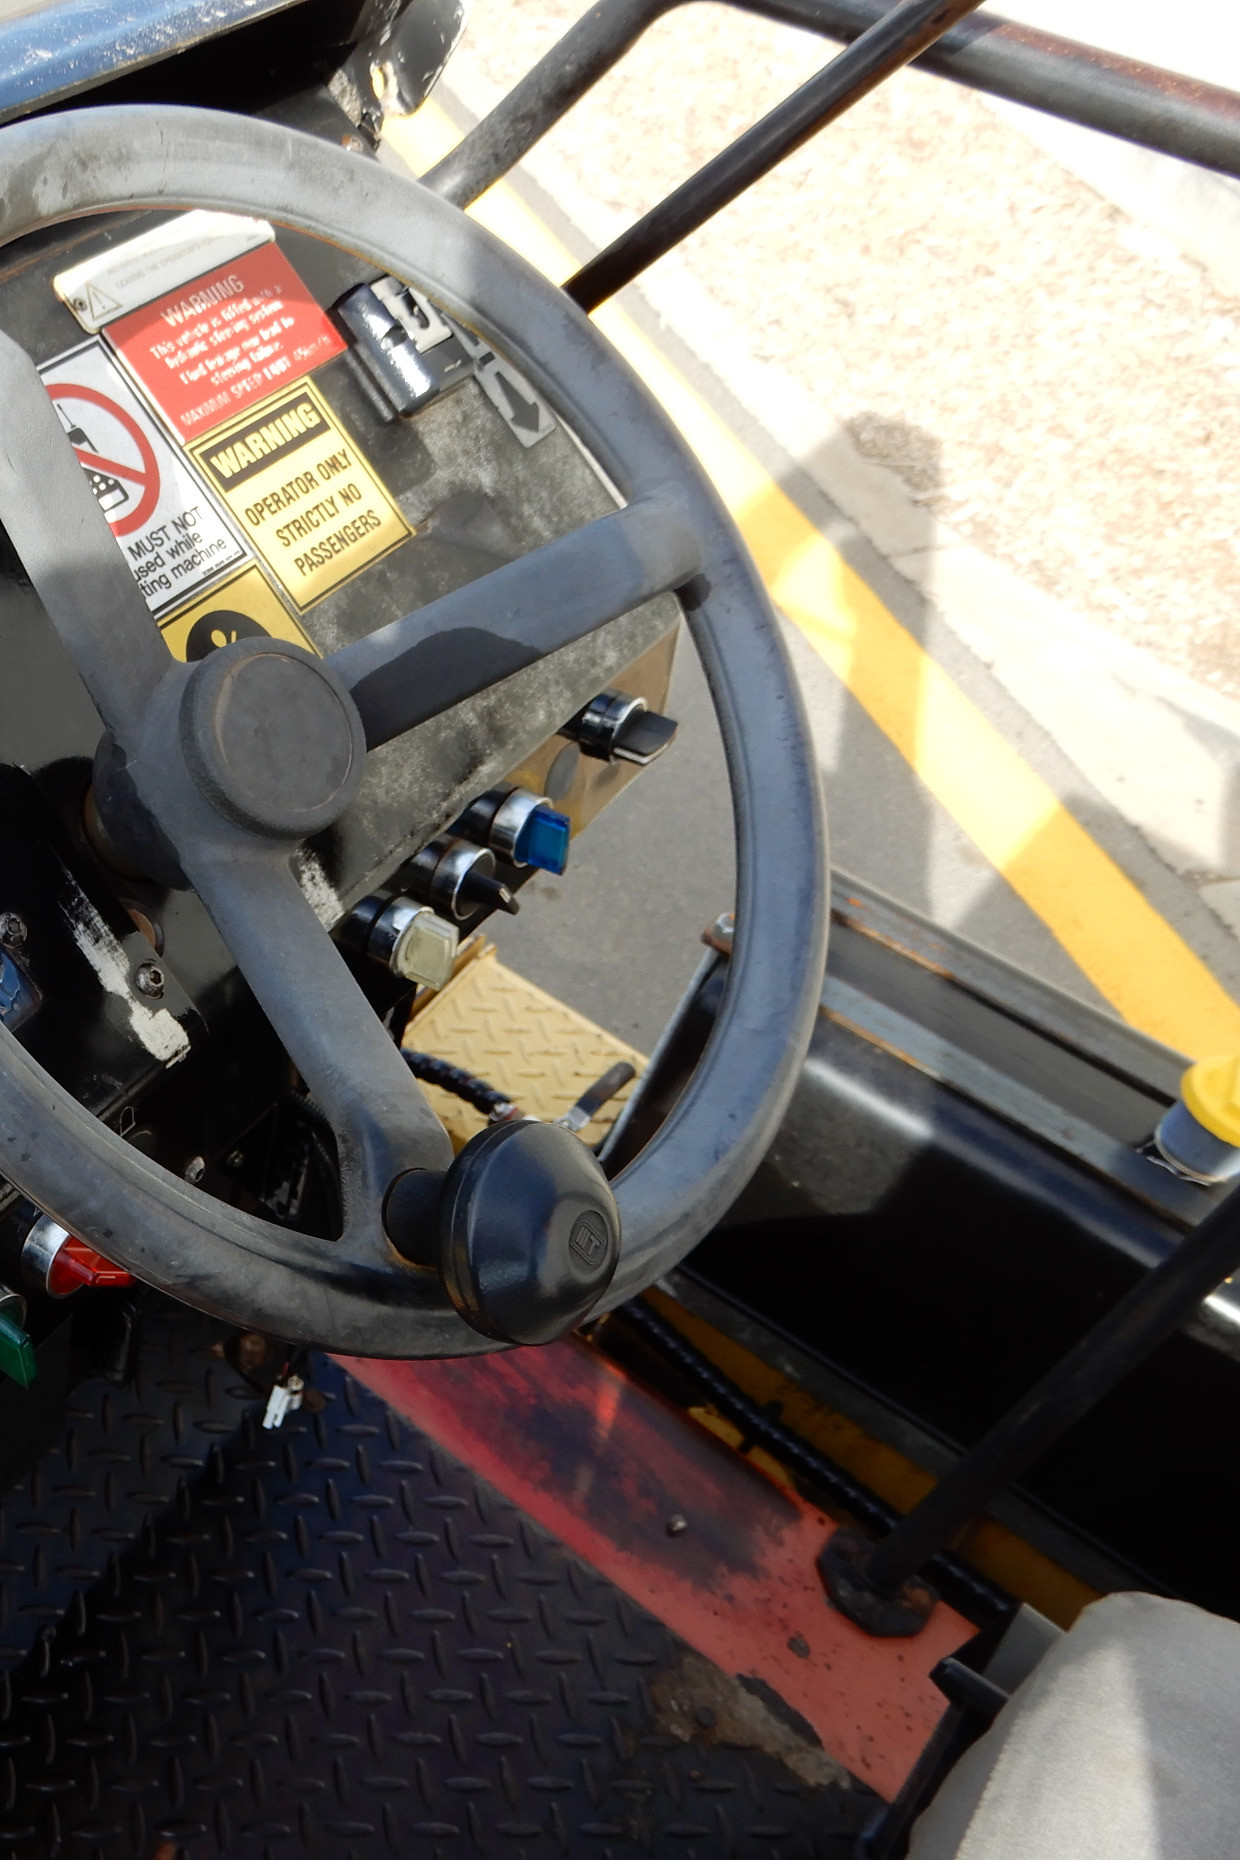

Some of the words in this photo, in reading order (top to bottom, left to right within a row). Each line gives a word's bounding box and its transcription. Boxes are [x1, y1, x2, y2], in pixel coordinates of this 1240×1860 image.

[150, 341, 175, 359] This
[176, 323, 209, 346] vehicle
[221, 299, 252, 321] fitted
[161, 276, 243, 327] WARNING
[165, 341, 208, 369] hydraulic
[209, 319, 249, 346] steering
[211, 358, 251, 385] steering
[181, 391, 230, 425] MAXIMUM
[231, 373, 262, 398] SPEED
[263, 356, 291, 379] LIMIT
[210, 402, 321, 479] WARNING
[244, 471, 320, 527] OPERATOR
[316, 449, 352, 481] ONLY
[276, 496, 340, 547] STRICTLY
[337, 483, 362, 506] NO
[127, 525, 171, 561] MUST
[171, 506, 203, 535] NOT
[165, 532, 203, 559] while
[171, 538, 227, 579] machine
[294, 509, 382, 577] PASSENGERS
